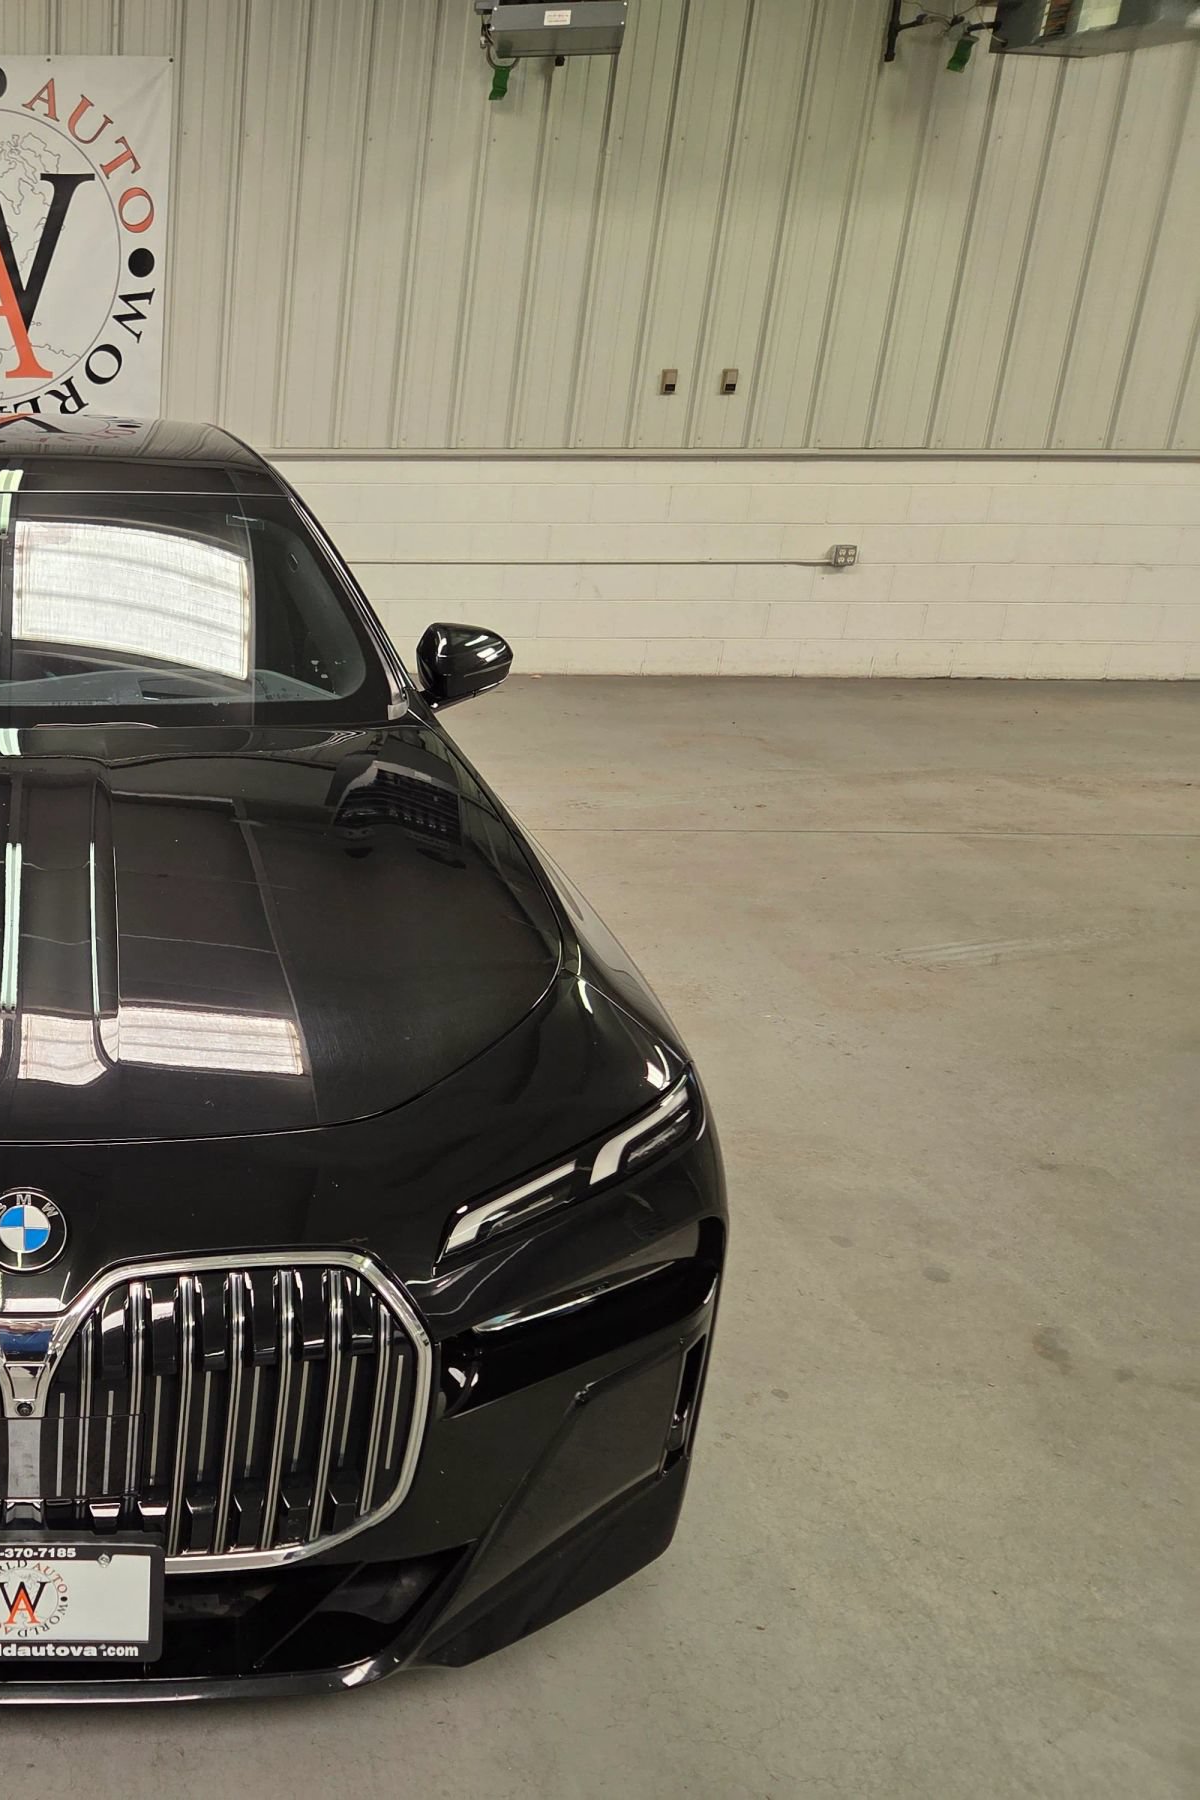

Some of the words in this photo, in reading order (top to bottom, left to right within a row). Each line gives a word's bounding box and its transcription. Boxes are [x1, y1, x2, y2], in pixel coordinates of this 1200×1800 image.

[22, 78, 155, 233] AUTO
[32, 1562, 68, 1594] AUTO
[17, 1604, 68, 1637] WORLD
